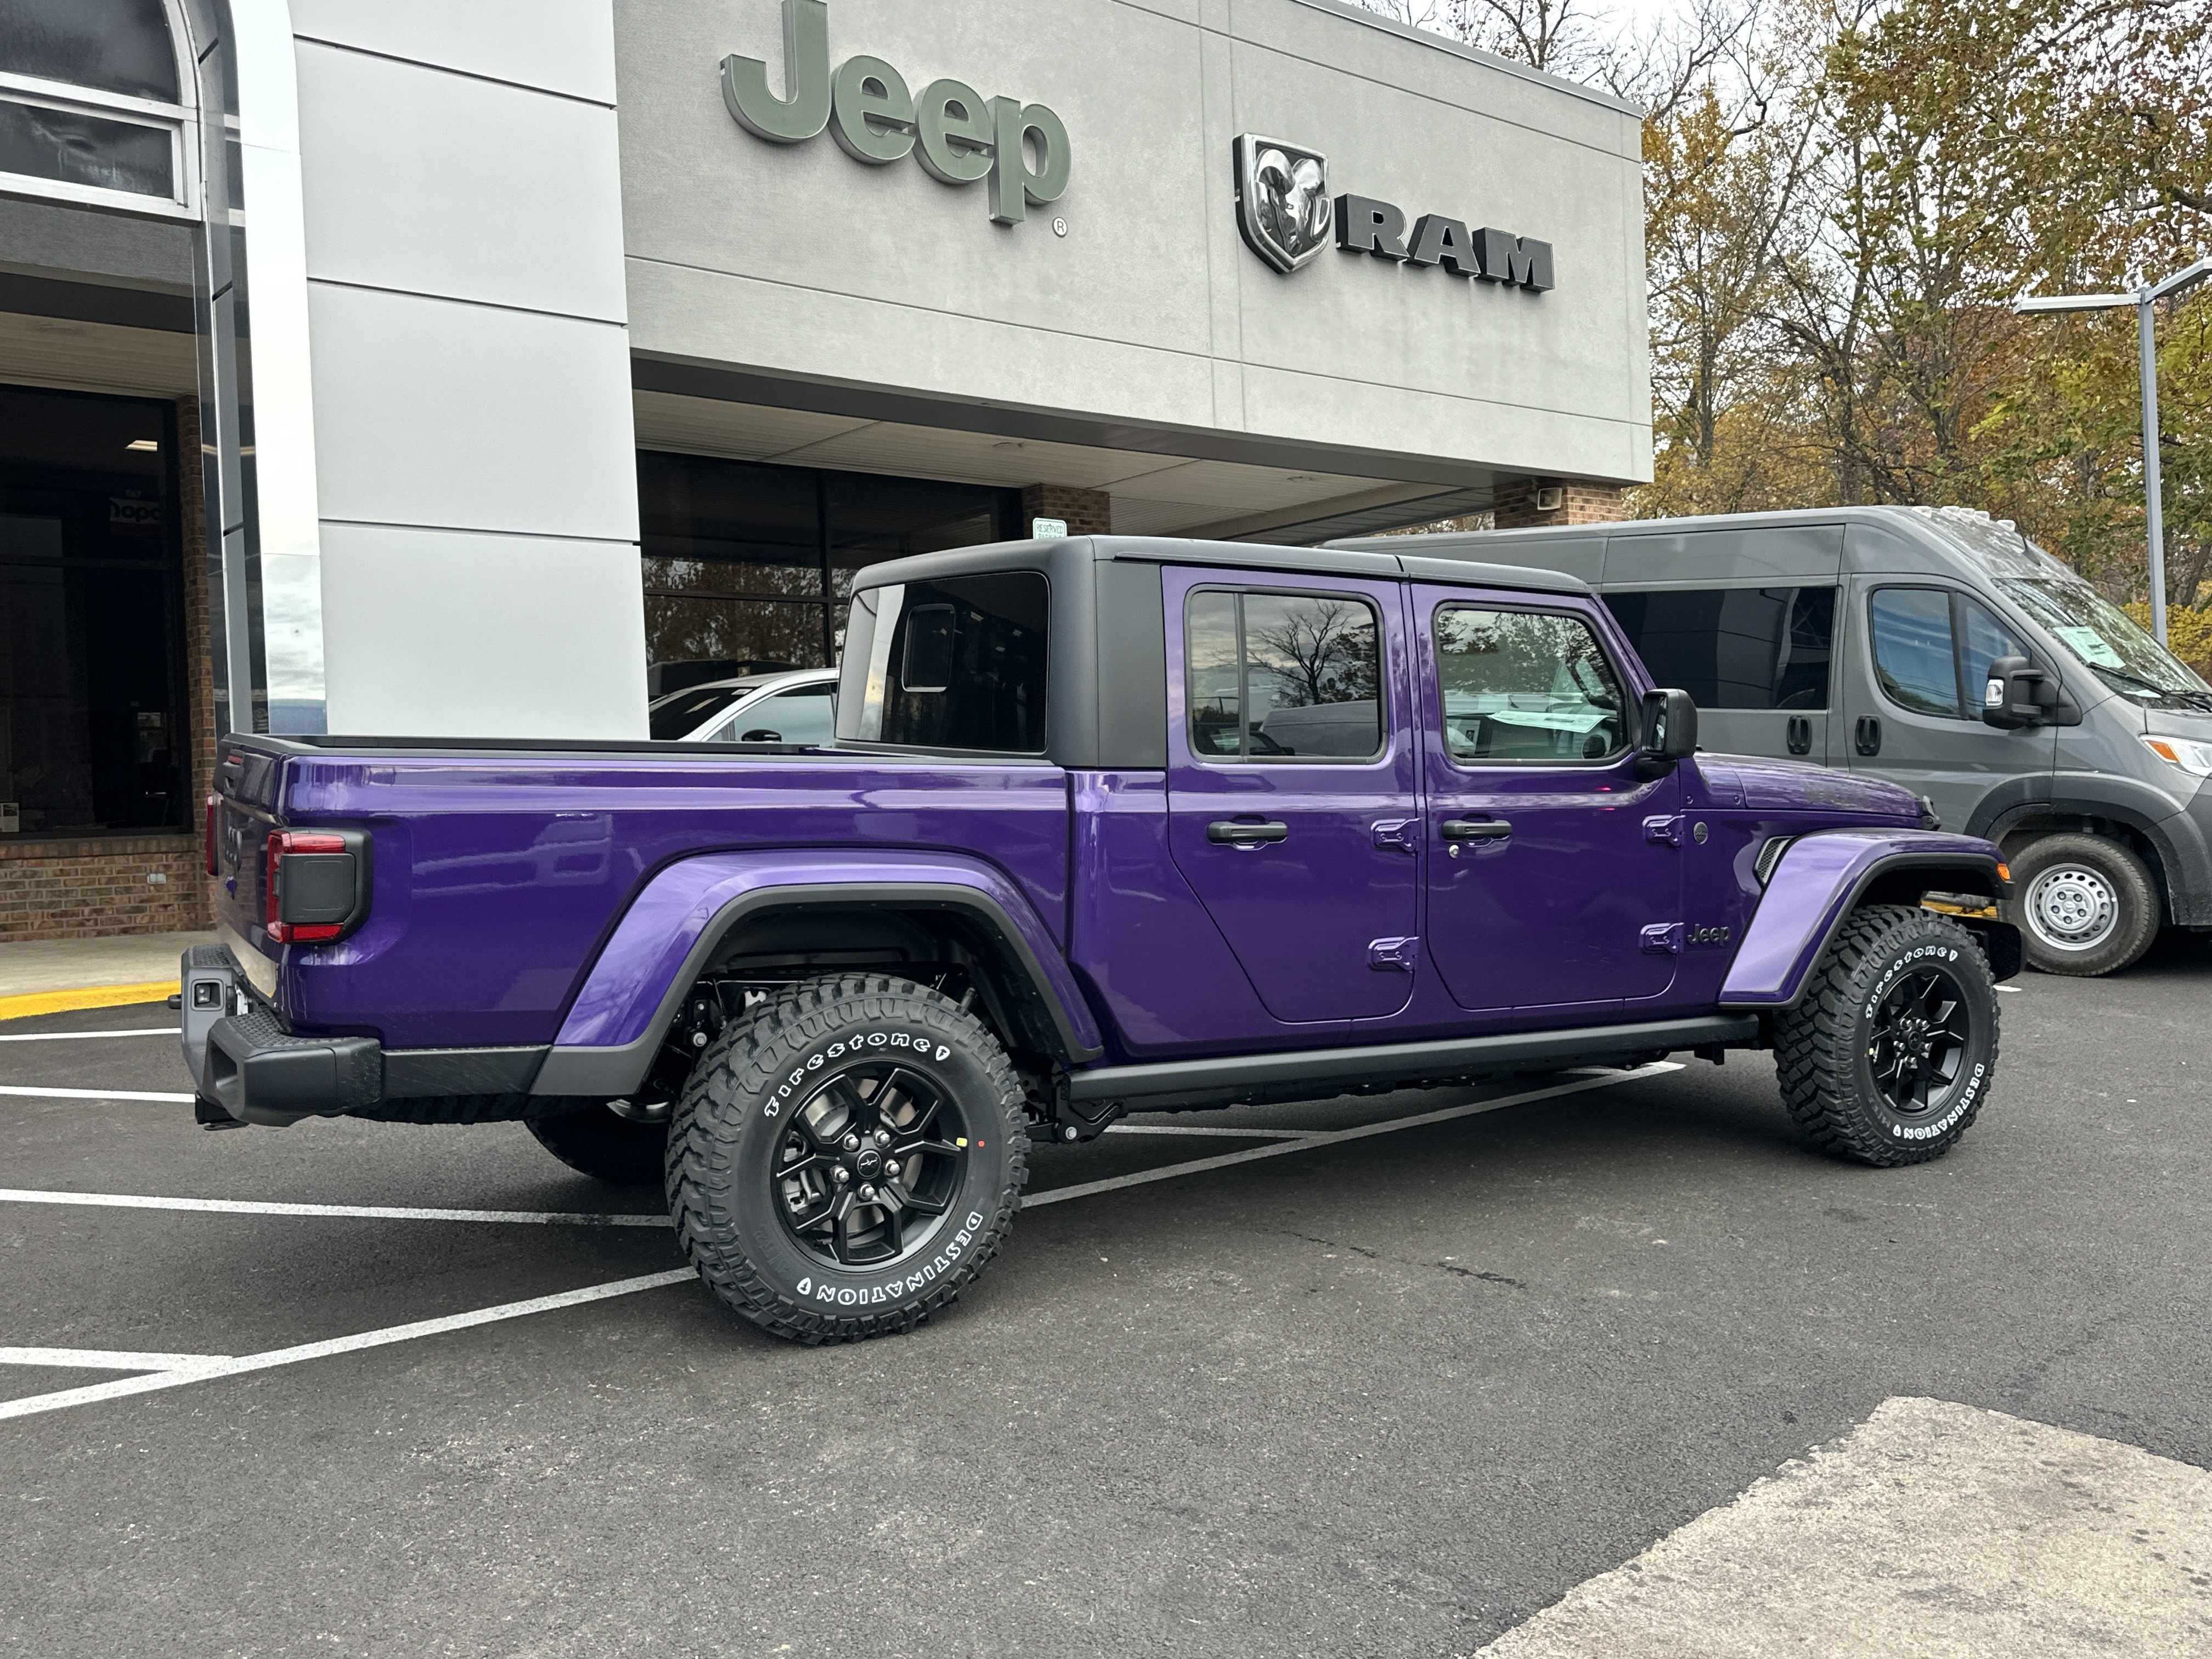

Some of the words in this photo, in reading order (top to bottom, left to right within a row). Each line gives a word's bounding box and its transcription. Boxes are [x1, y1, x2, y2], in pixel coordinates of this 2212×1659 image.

[720, 0, 1071, 226] Jeep
[1335, 193, 1555, 292] RAM
[1036, 523, 1063, 534] RESERVED
[1686, 923, 1730, 946] Jeep
[1866, 946, 1948, 1019] Firestone
[764, 1033, 931, 1116] Firestone
[1904, 1063, 1985, 1140] DESTINATION
[816, 1211, 984, 1305] DESTINATION
